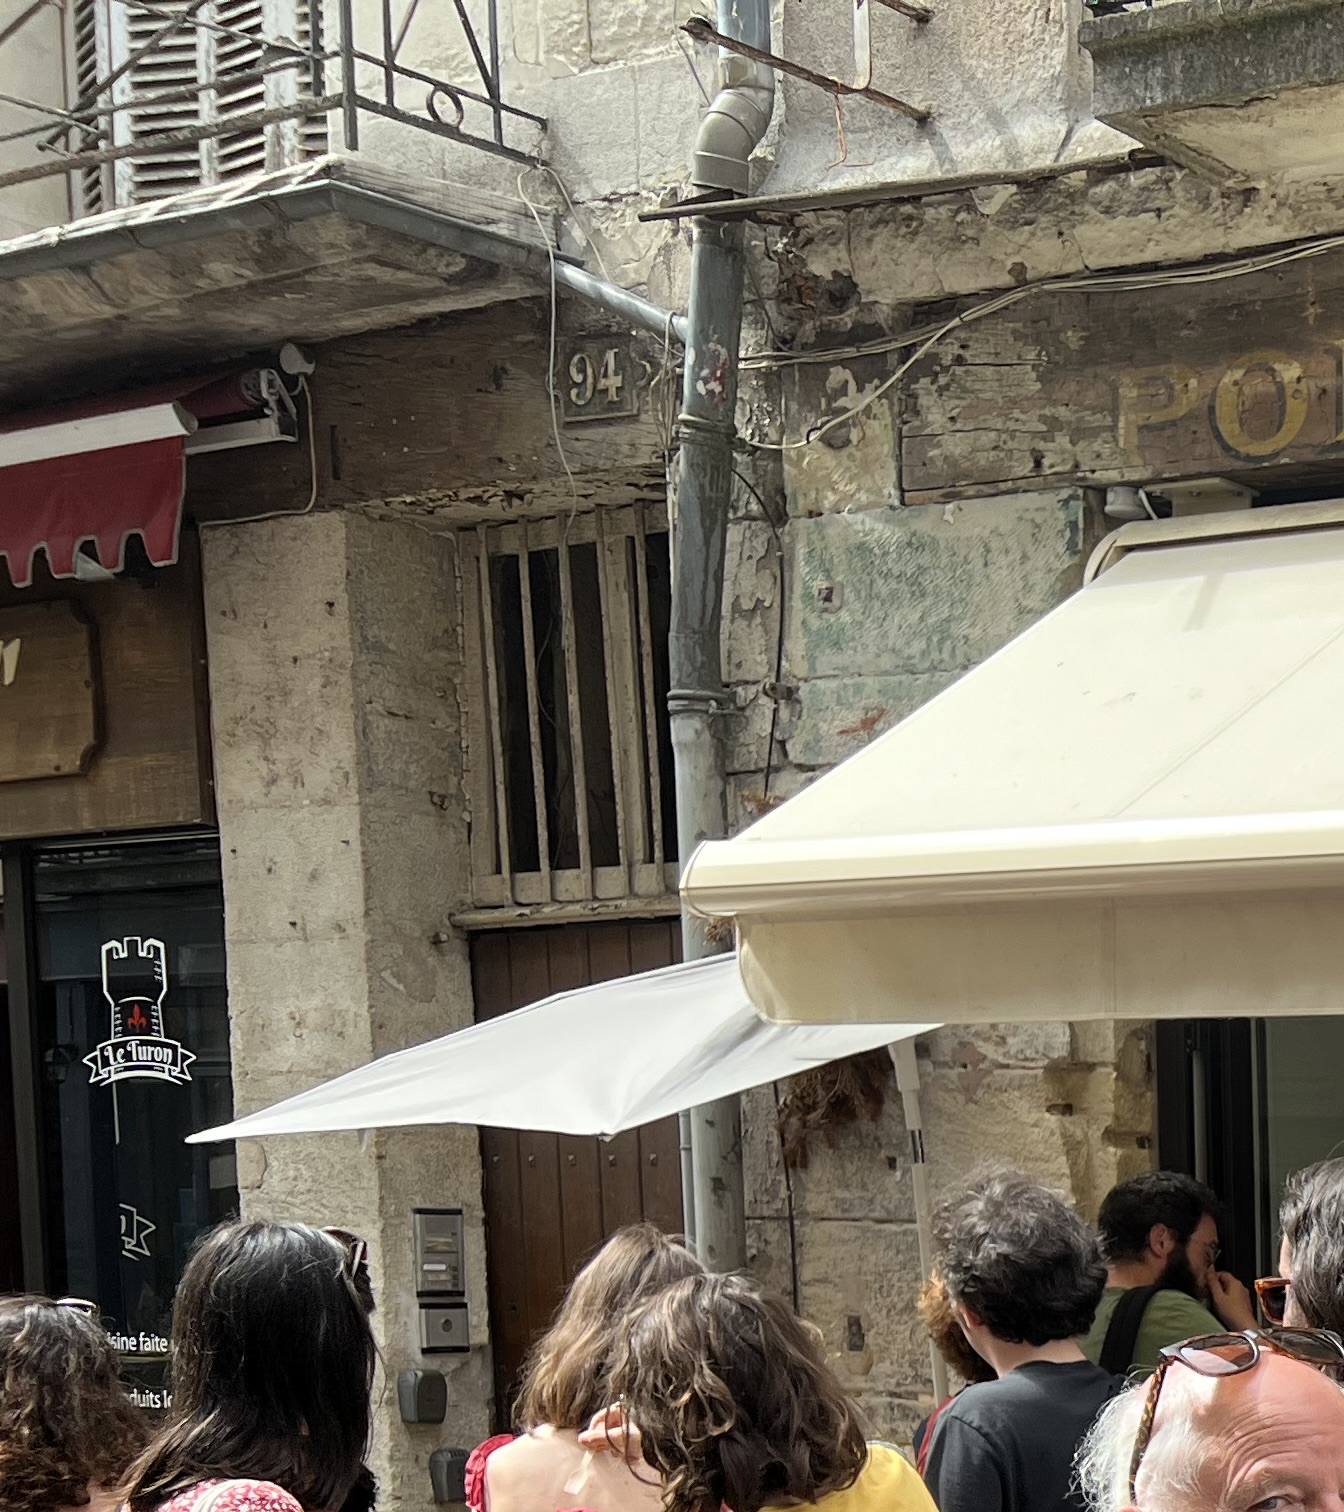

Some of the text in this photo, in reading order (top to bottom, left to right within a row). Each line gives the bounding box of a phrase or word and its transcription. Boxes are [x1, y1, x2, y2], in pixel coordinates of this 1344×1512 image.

[569, 348, 622, 405] 94
[103, 1040, 173, 1066] Le Turon
[139, 1332, 168, 1352] faite
